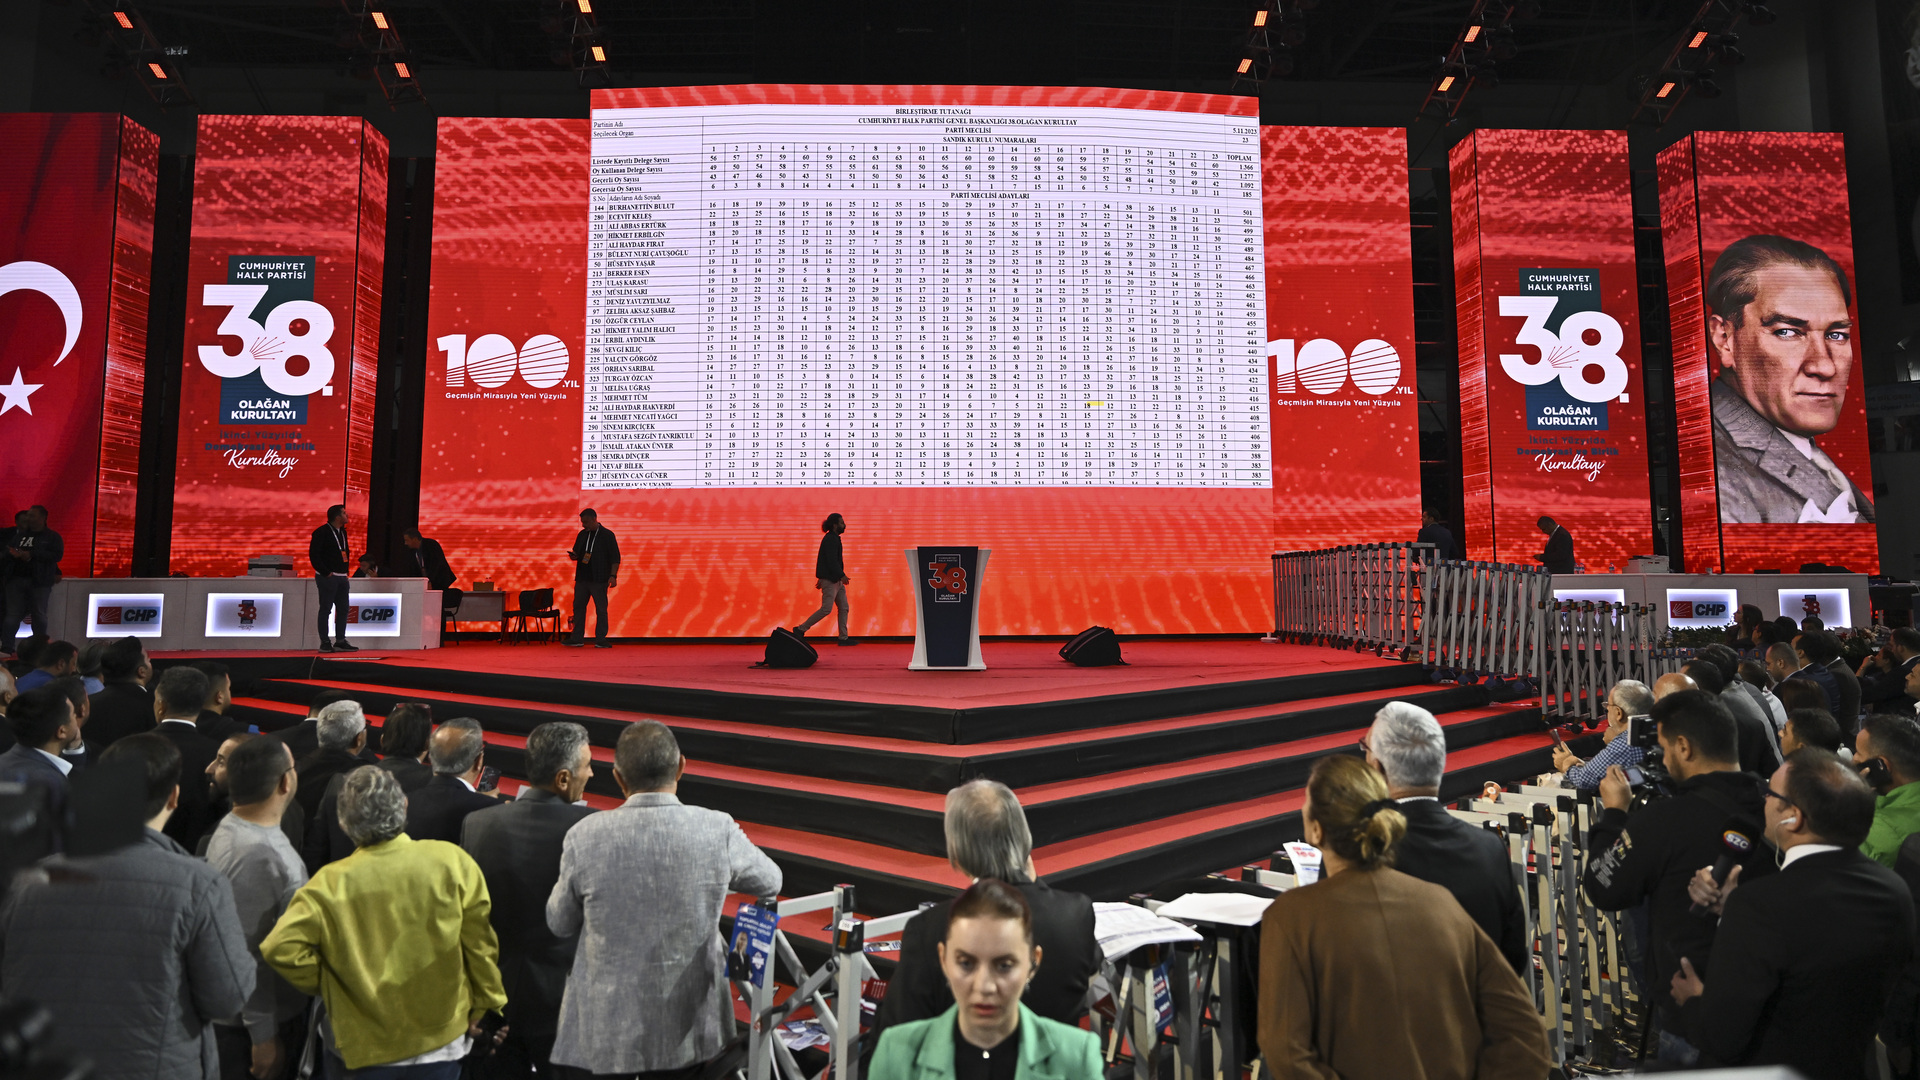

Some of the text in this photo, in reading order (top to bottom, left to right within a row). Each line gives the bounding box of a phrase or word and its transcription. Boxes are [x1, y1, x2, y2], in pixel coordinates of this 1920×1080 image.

[1529, 274, 1589, 282] CUMHURİYET
[437, 334, 569, 388] 100
[239, 398, 289, 408] OLAĞAN
[231, 411, 296, 419] KURULTAYI
[1544, 405, 1590, 415] OLAĞAN
[1537, 417, 1597, 425] KURULTAYI
[220, 431, 302, 440] İkinci Yüzyılda
[1529, 435, 1605, 445] İkinci Yüzyılda
[224, 449, 298, 478] Kurultayı
[1535, 453, 1604, 481] Kurultayı
[124, 609, 157, 621] CHP
[361, 609, 394, 621] CHP
[1695, 604, 1726, 616] CHP
[1726, 834, 1748, 848] SZC
